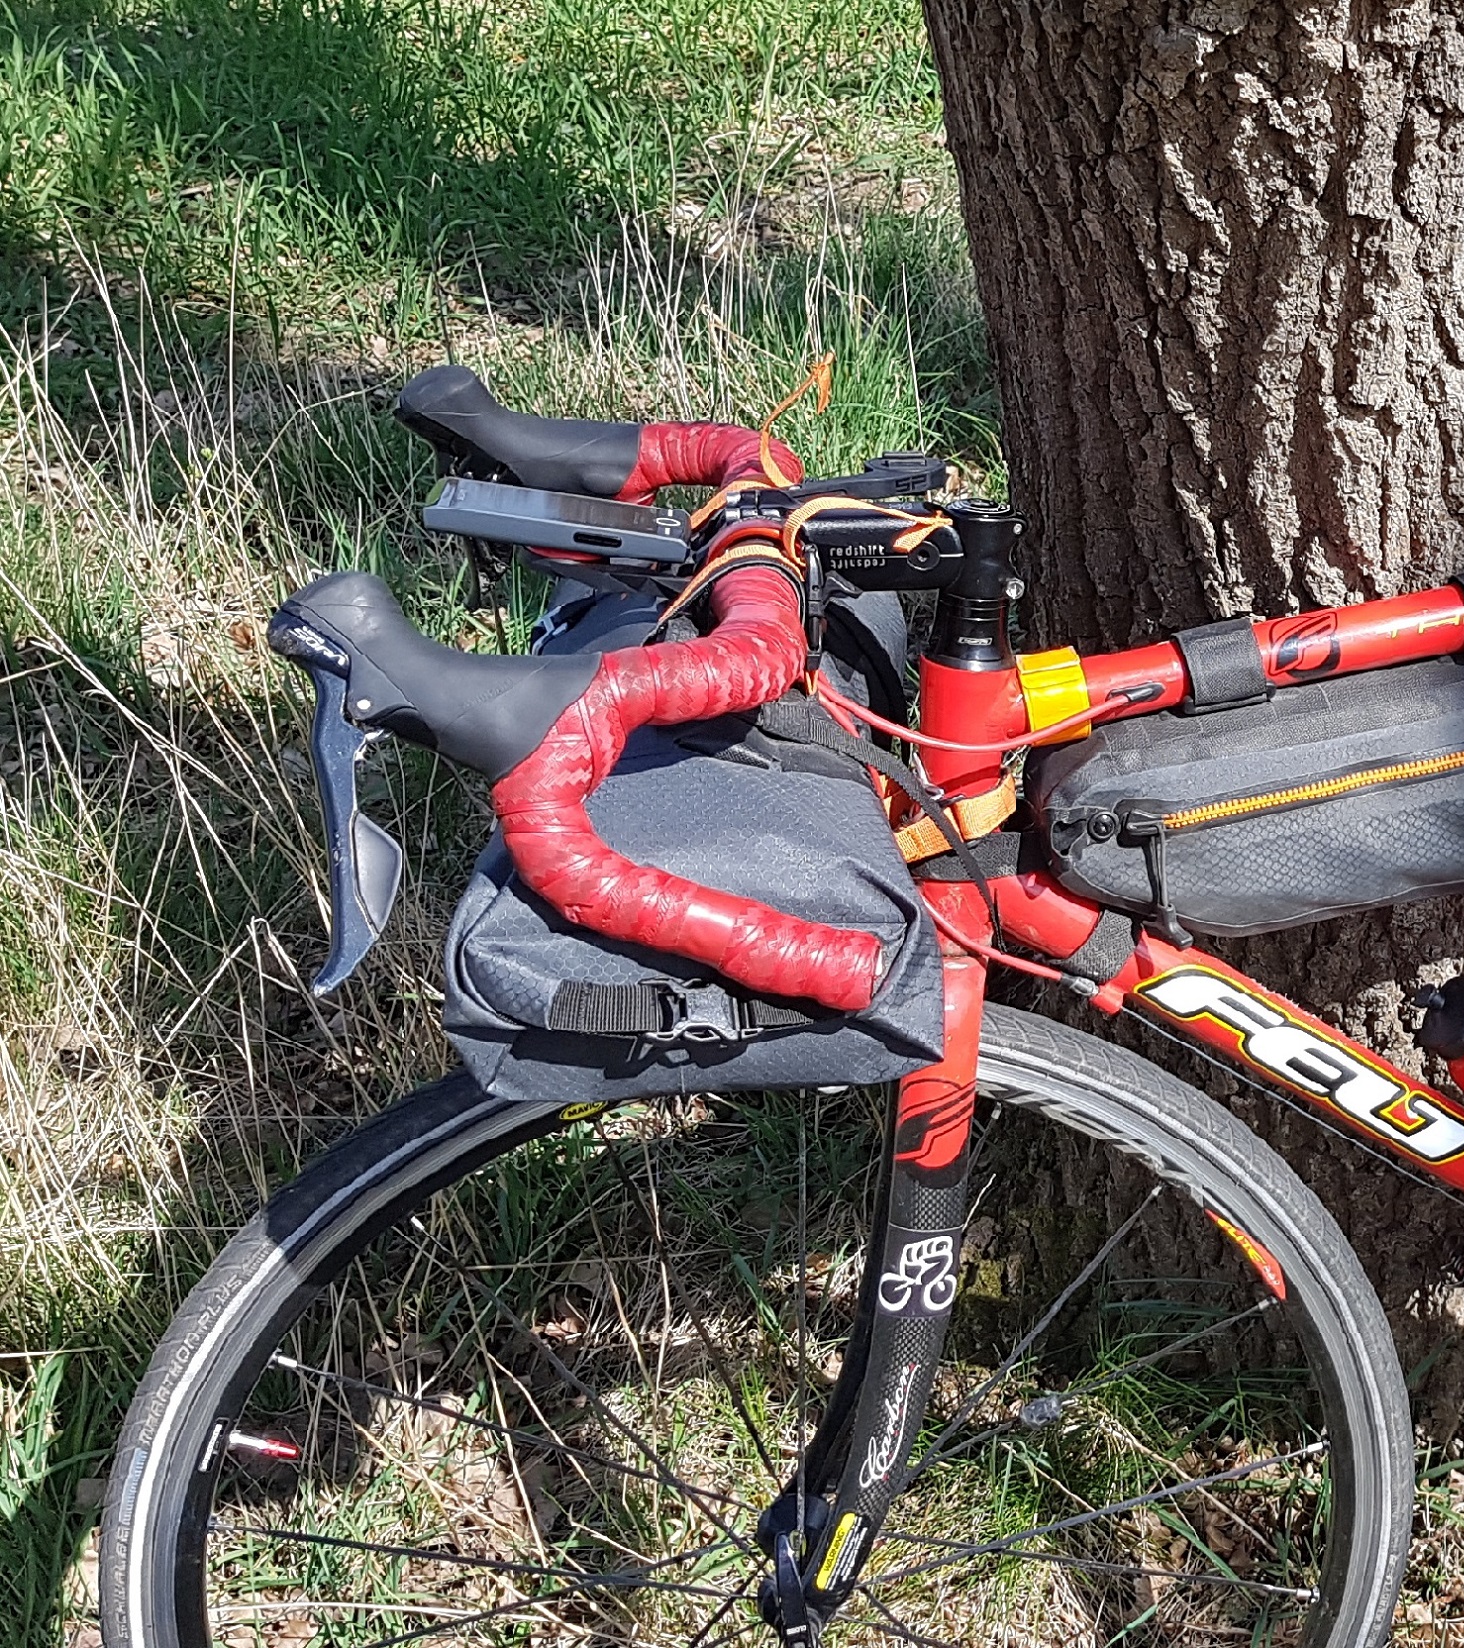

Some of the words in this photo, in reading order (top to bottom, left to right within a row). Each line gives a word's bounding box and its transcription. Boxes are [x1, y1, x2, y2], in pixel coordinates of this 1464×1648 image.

[829, 545, 885, 557] redshift
[568, 1102, 600, 1117] MAVIC
[139, 1332, 201, 1445] MARATHON
[198, 1275, 243, 1327] PLUS
[860, 1363, 920, 1488] Carbon
[824, 1528, 845, 1571] WARNING
